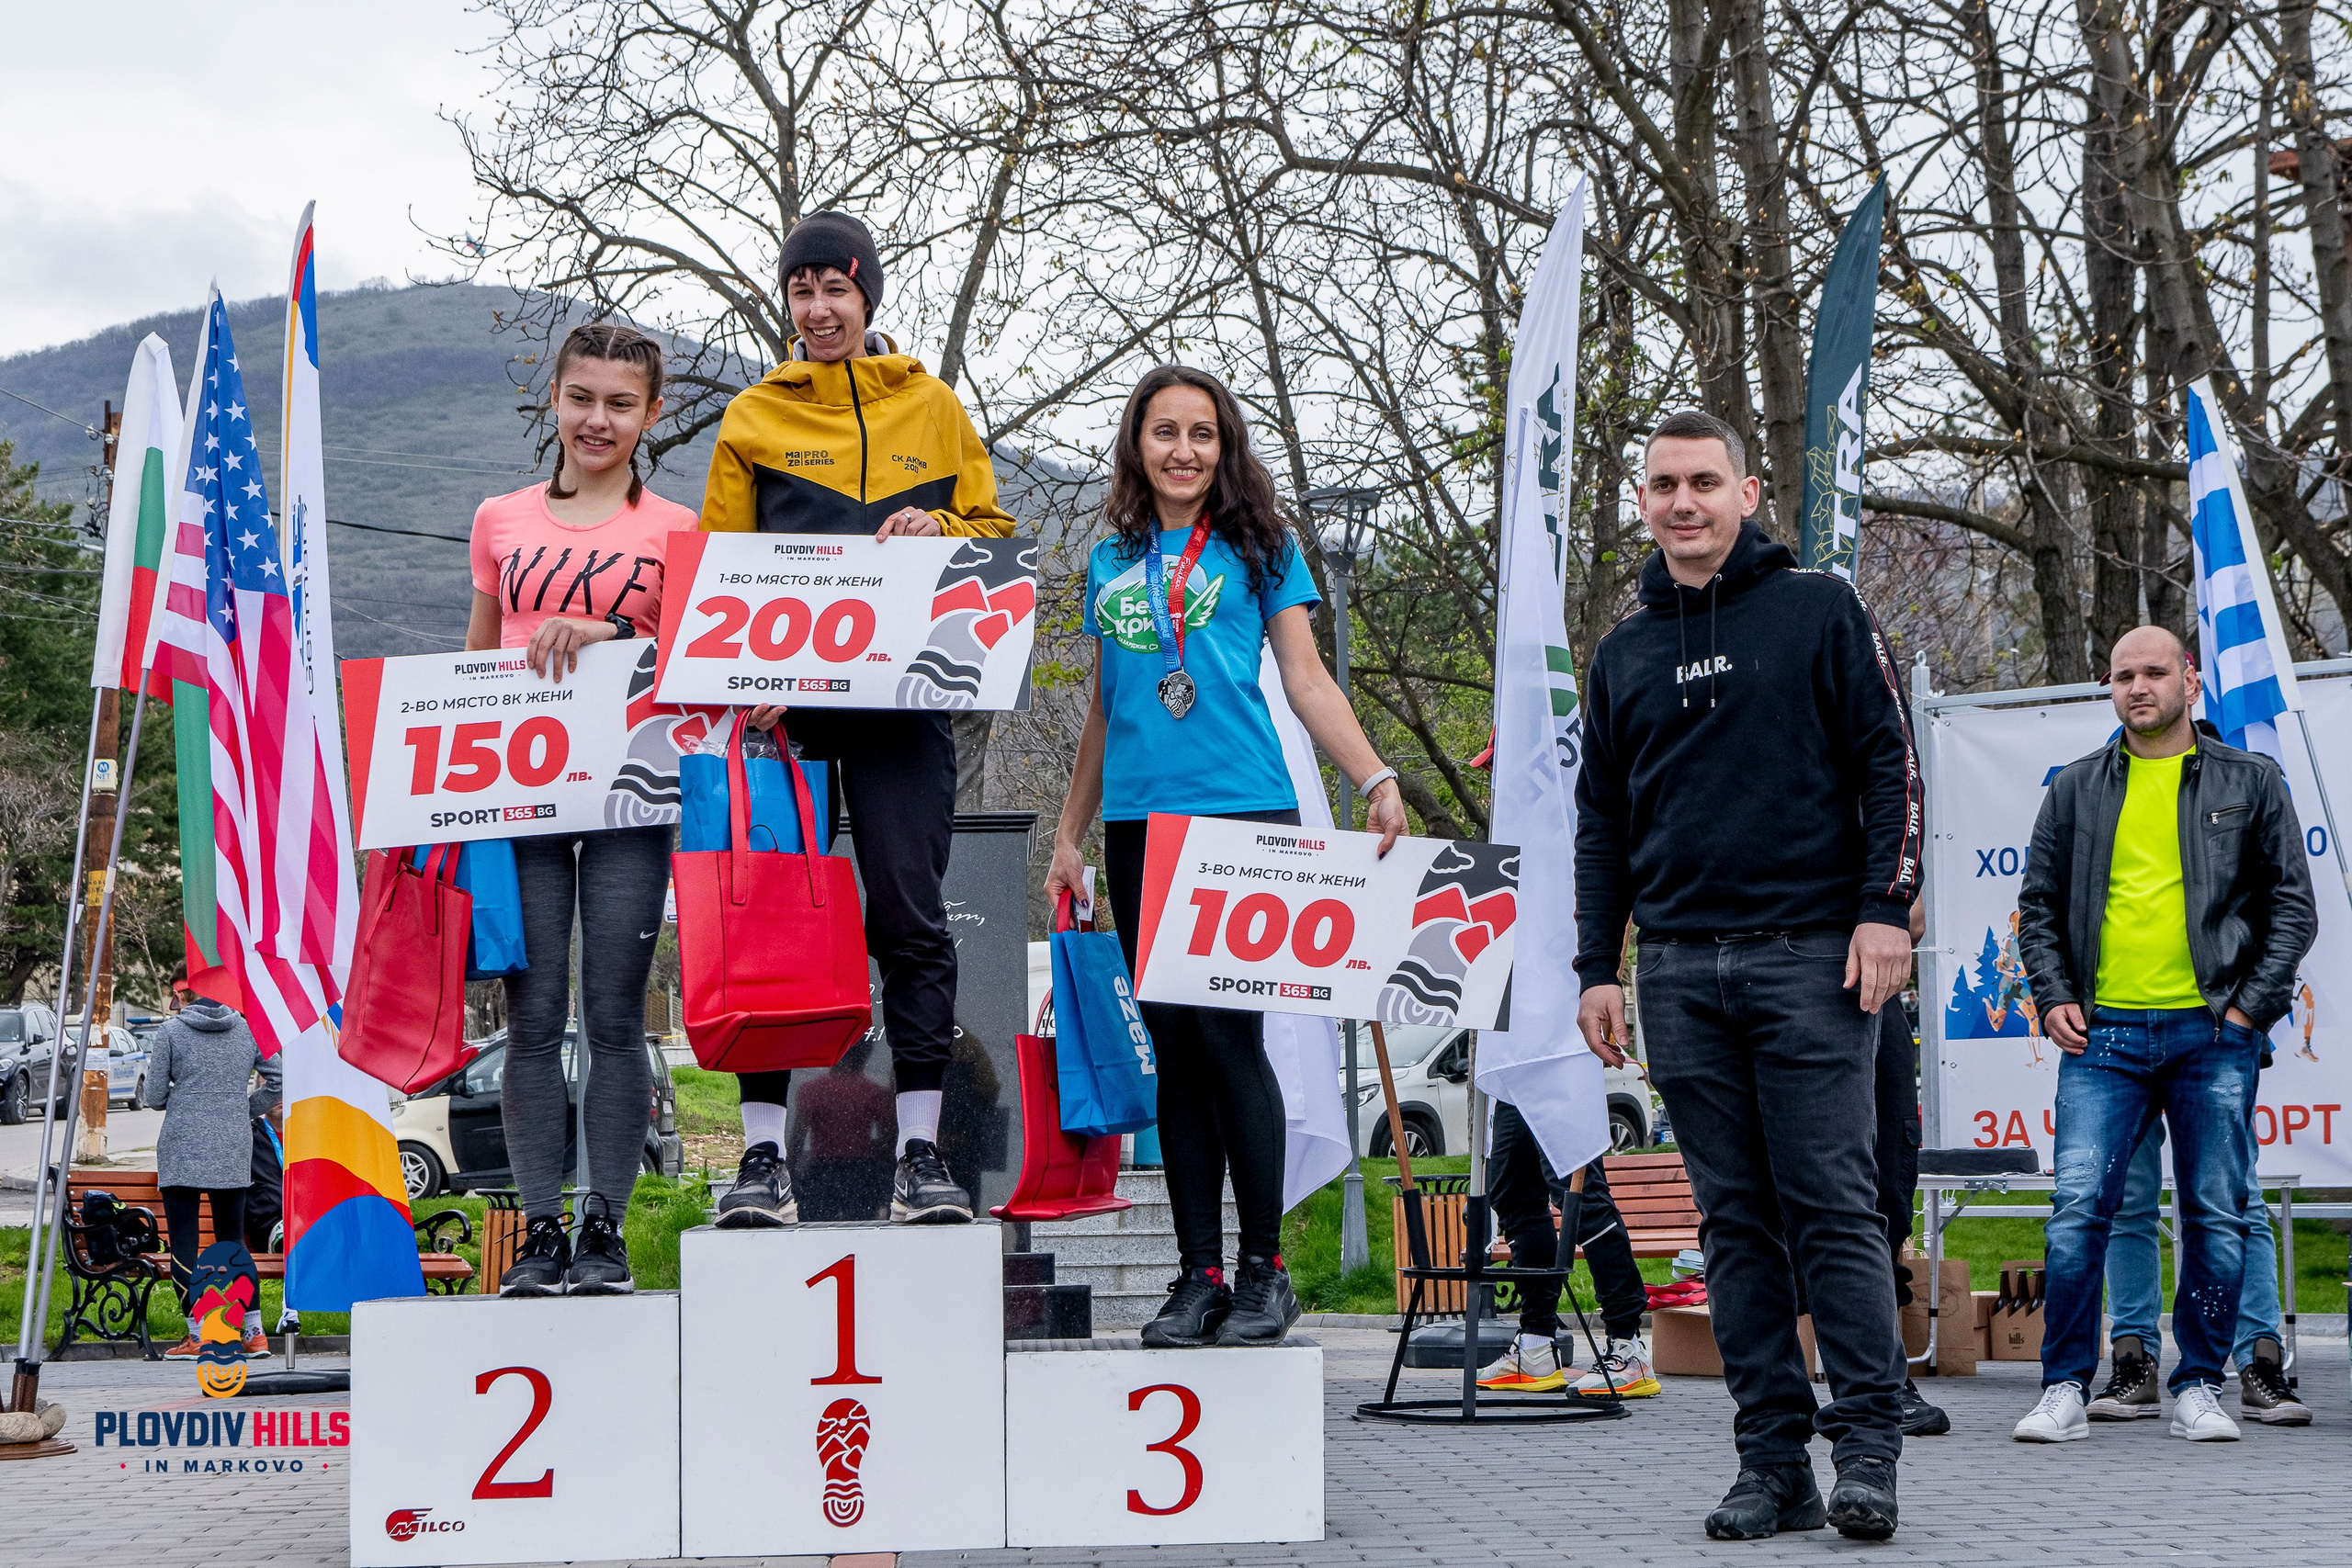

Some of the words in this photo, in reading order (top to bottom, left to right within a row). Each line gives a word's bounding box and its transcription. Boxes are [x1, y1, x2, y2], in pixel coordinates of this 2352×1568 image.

[804, 450, 829, 458] PRO
[775, 544, 816, 556] PLOVDIV
[817, 546, 843, 556] HILLS
[501, 547, 656, 621] NIKE
[719, 573, 752, 585] 1-ВО
[755, 574, 810, 587] МЯСТО
[813, 576, 834, 587] 8К
[835, 577, 883, 588] ЖЕНИ
[1120, 597, 1153, 616] Бе
[684, 595, 876, 663] 200
[1114, 616, 1157, 638] кри
[865, 651, 893, 663] лв.
[1871, 632, 1888, 668] BALR.
[454, 661, 497, 675] PLOVDIV
[498, 660, 526, 671] HILLS
[480, 672, 514, 681] MARKOVO
[1676, 656, 1733, 684] BALR.
[401, 700, 438, 714] 2-ВО
[443, 695, 498, 710] МЯСТО
[502, 694, 522, 705] 8К
[526, 690, 573, 705] ЖЕНИ
[404, 716, 570, 795] 150
[1906, 744, 1917, 780] BALR.
[566, 771, 593, 783] лв.
[1908, 800, 1919, 837] BALR.
[1256, 834, 1297, 849] PLOVDIV
[1298, 838, 1326, 851] HILLS
[1198, 863, 1236, 876] 3-ВО
[1238, 866, 1294, 882] МЯСТО
[1295, 872, 1317, 885] 8К
[1318, 874, 1367, 888] ЖЕНИ
[1187, 887, 1355, 968] 100
[1345, 958, 1372, 971] лв.
[1973, 1110, 2032, 1148] ЗА
[2254, 1104, 2341, 1145] ОРТ
[805, 1254, 883, 1386] 1
[471, 1366, 555, 1501] 2
[1126, 1383, 1204, 1517] 3
[388, 1520, 466, 1537] MILCO
